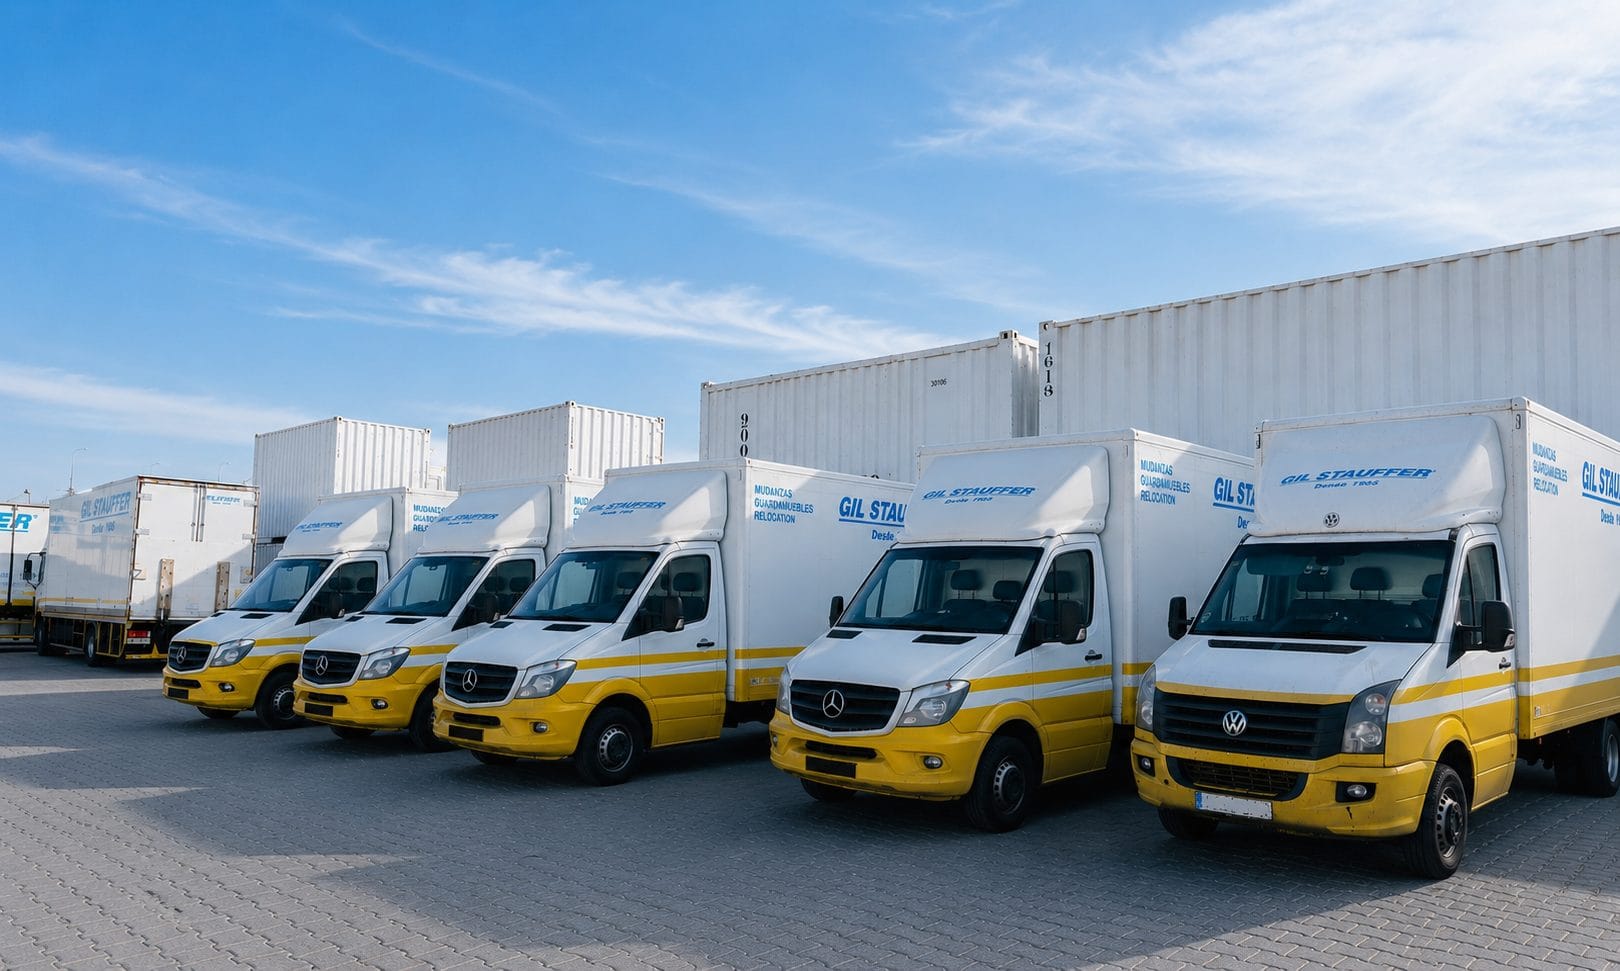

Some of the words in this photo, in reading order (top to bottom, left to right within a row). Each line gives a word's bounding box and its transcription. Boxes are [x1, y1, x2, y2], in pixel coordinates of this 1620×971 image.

[1044, 342, 1053, 397] 1618
[1280, 473, 1310, 486] GIL
[1316, 468, 1434, 481] STAUFFER
[1582, 461, 1597, 492] GIL
[754, 484, 793, 499] MUDANZAS
[923, 489, 946, 500] GIL
[949, 486, 1036, 497] STAUFFER
[1140, 489, 1176, 505] RELOCATION
[1213, 477, 1234, 503] GIL
[754, 497, 814, 514] GUARDAMUEBLES
[838, 496, 865, 519] GIL
[754, 510, 796, 524] RELOCATION
[871, 529, 895, 541] Desde
